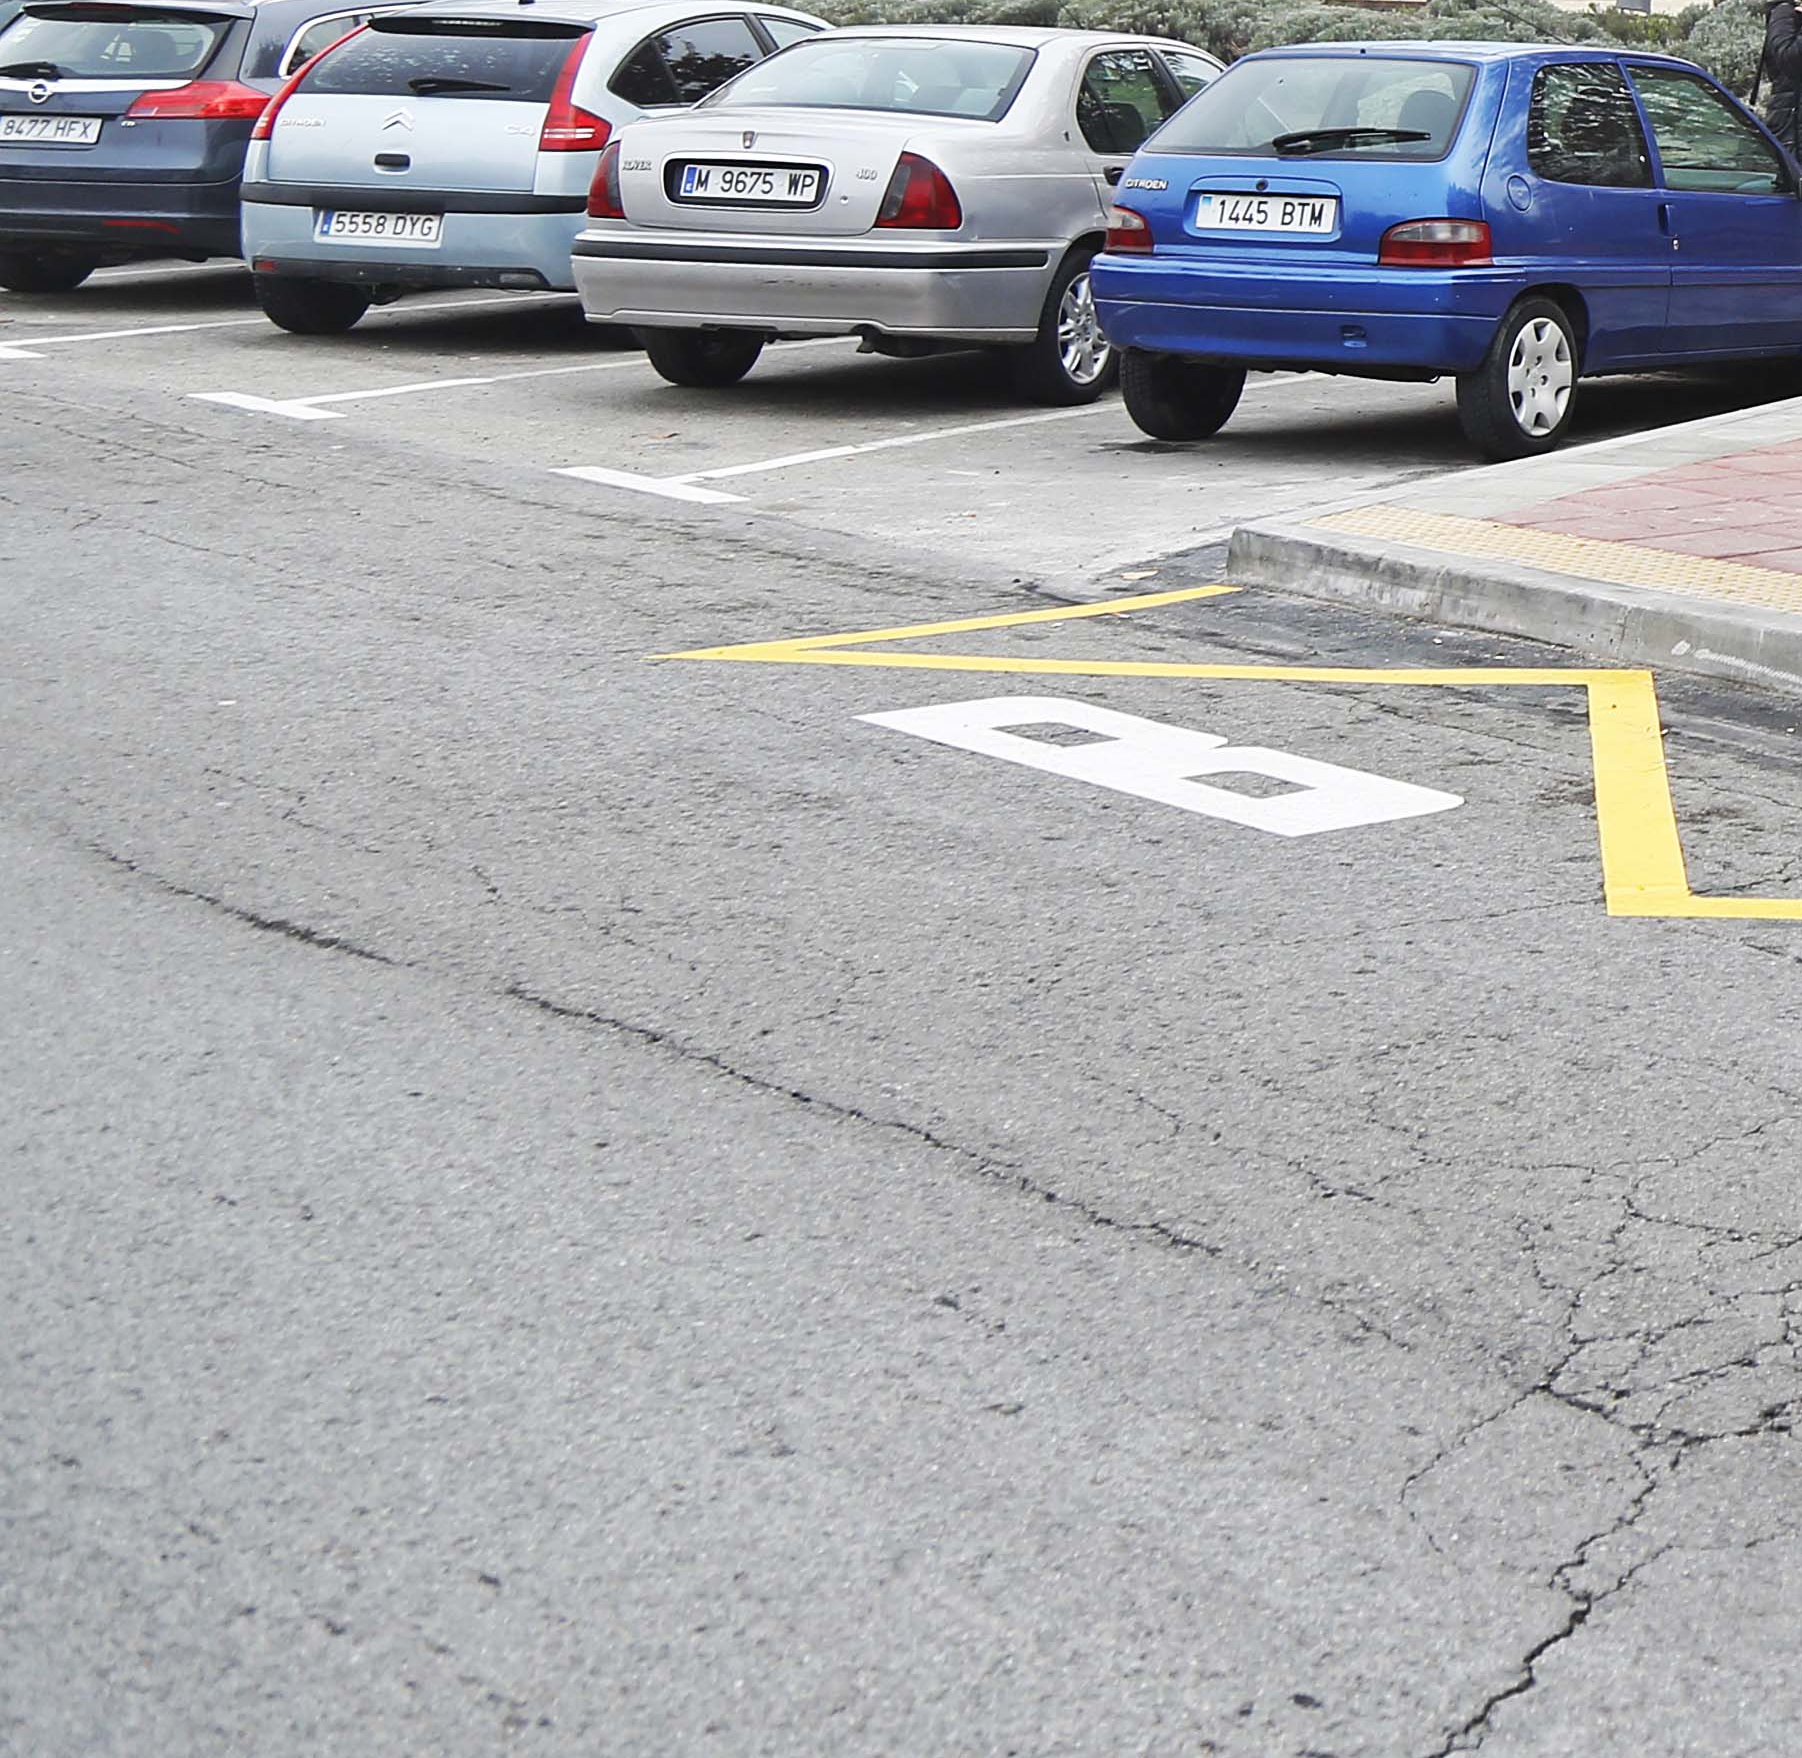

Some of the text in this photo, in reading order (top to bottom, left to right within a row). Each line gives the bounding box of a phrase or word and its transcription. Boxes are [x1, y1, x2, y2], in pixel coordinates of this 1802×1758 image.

[3, 118, 93, 139] 8477 HFX
[695, 169, 816, 197] M 9675 WP
[333, 212, 435, 237] 5558 DYG
[1217, 199, 1325, 228] 1445 BTM
